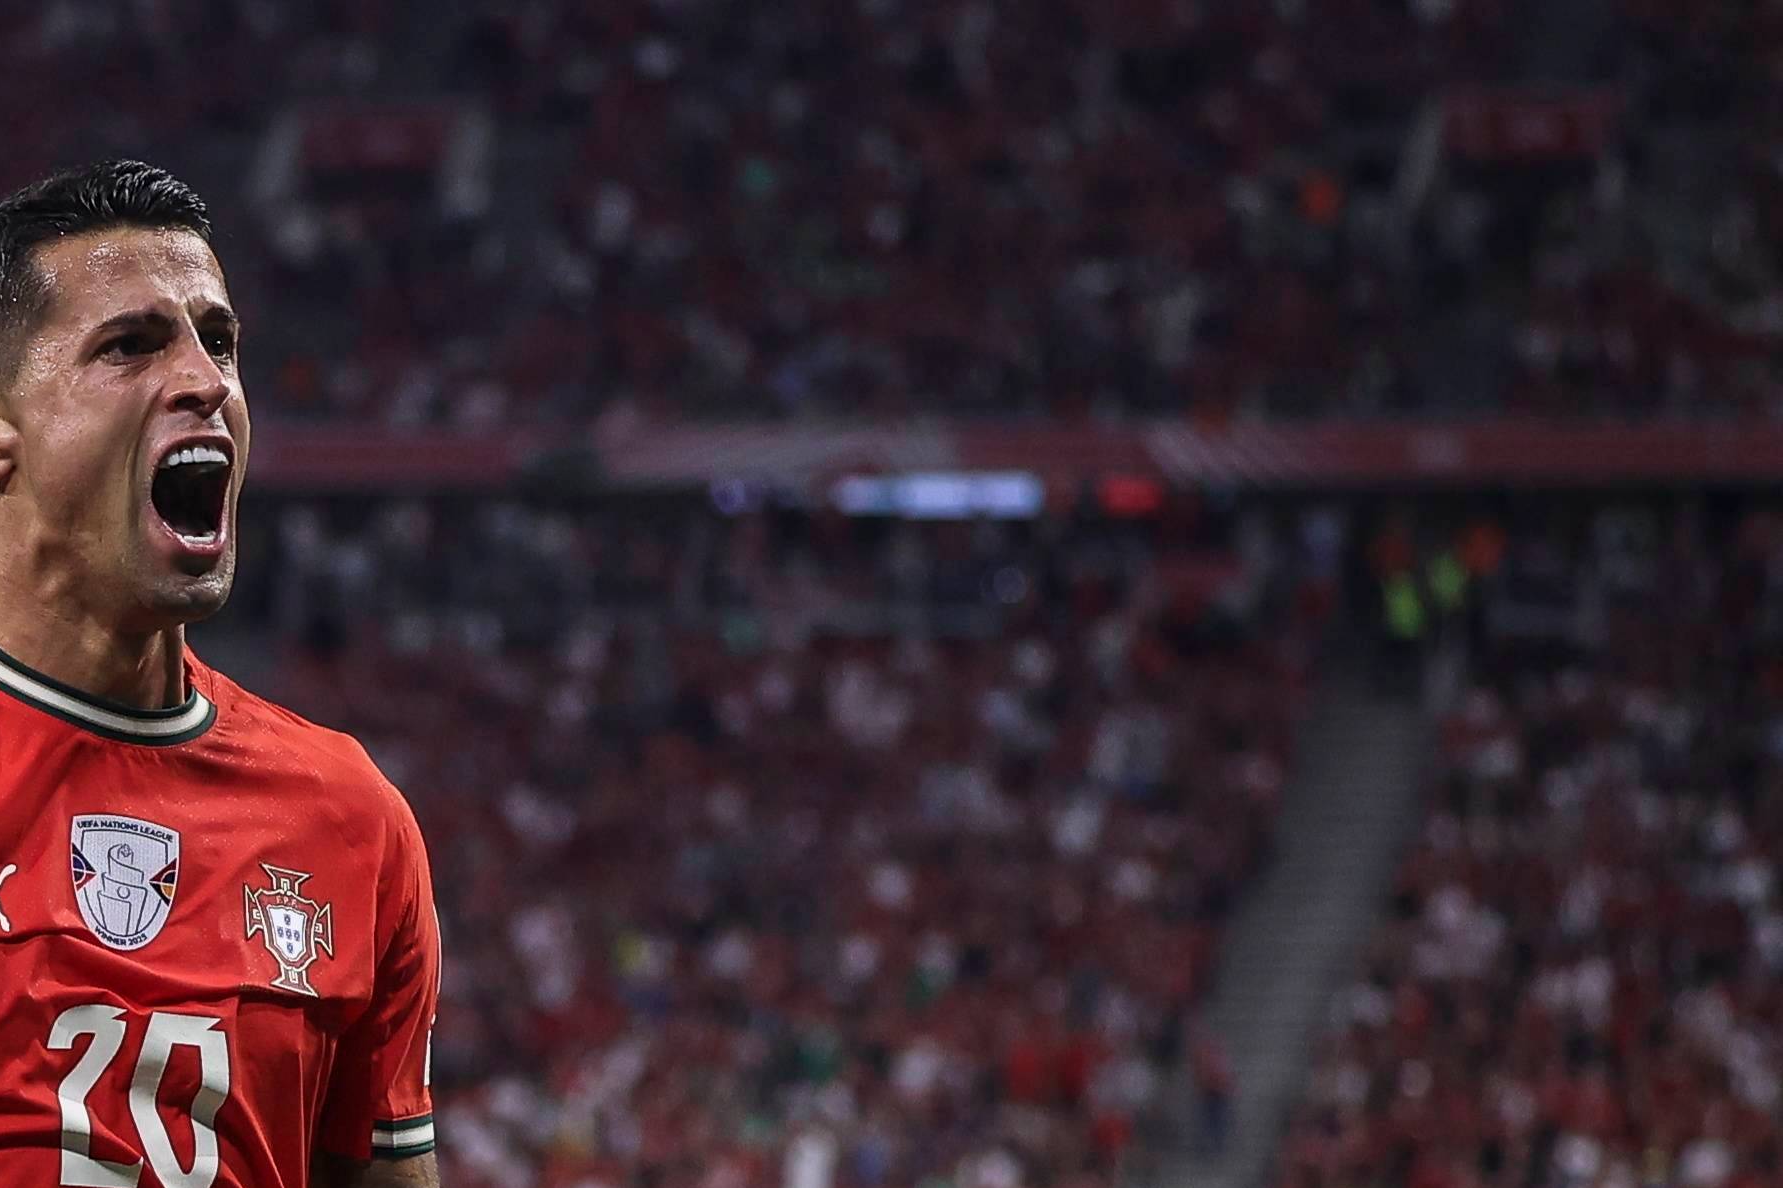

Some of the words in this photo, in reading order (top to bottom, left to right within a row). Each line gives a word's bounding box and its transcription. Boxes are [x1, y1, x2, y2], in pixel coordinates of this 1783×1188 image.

[77, 820, 99, 829] UEFA
[100, 820, 138, 832] NATIONS
[139, 825, 174, 843] LEAGUE
[95, 926, 127, 946] WINNER
[128, 933, 148, 946] 2025
